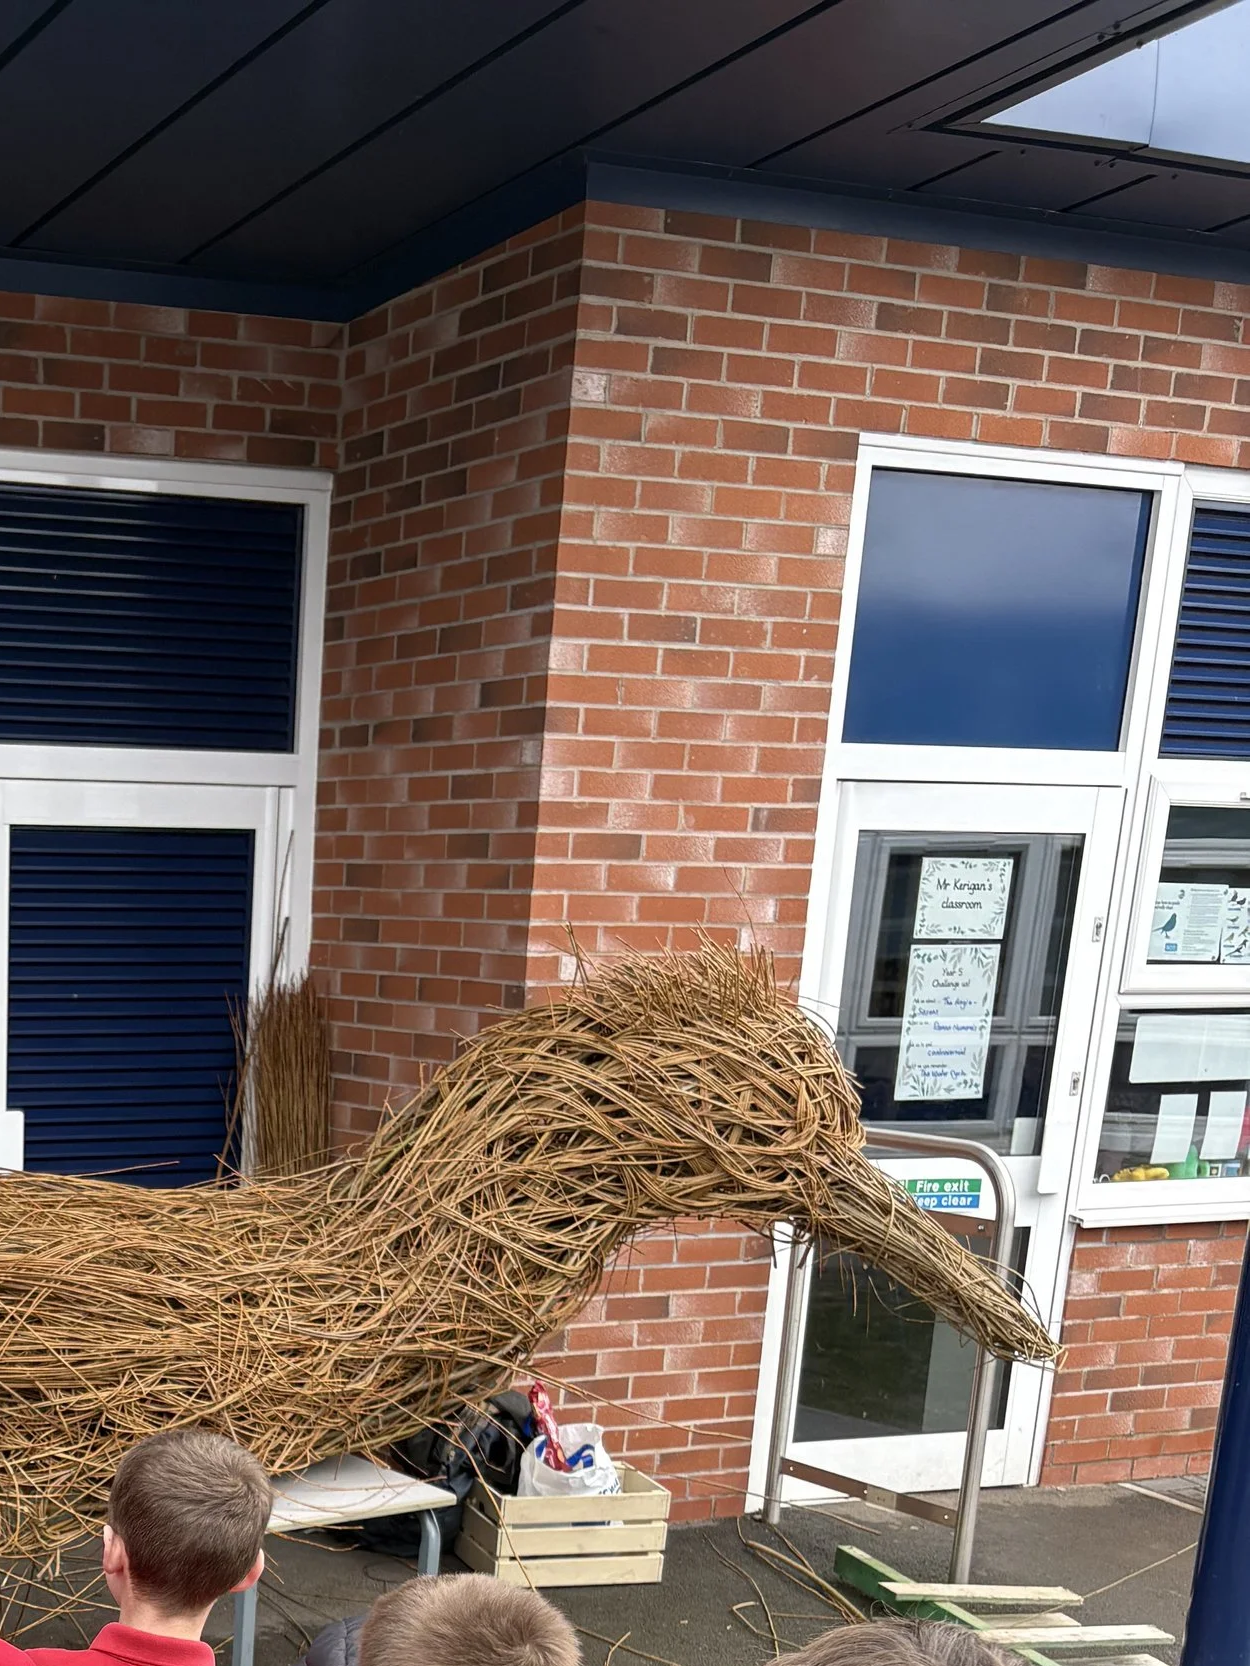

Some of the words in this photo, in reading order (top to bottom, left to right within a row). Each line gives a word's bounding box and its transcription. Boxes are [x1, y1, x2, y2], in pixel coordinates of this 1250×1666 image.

[936, 878, 951, 890] Mr
[941, 897, 982, 909] classroom
[916, 1181, 939, 1192] Fire
[944, 1180, 969, 1191] exit
[941, 1195, 972, 1206] clear
